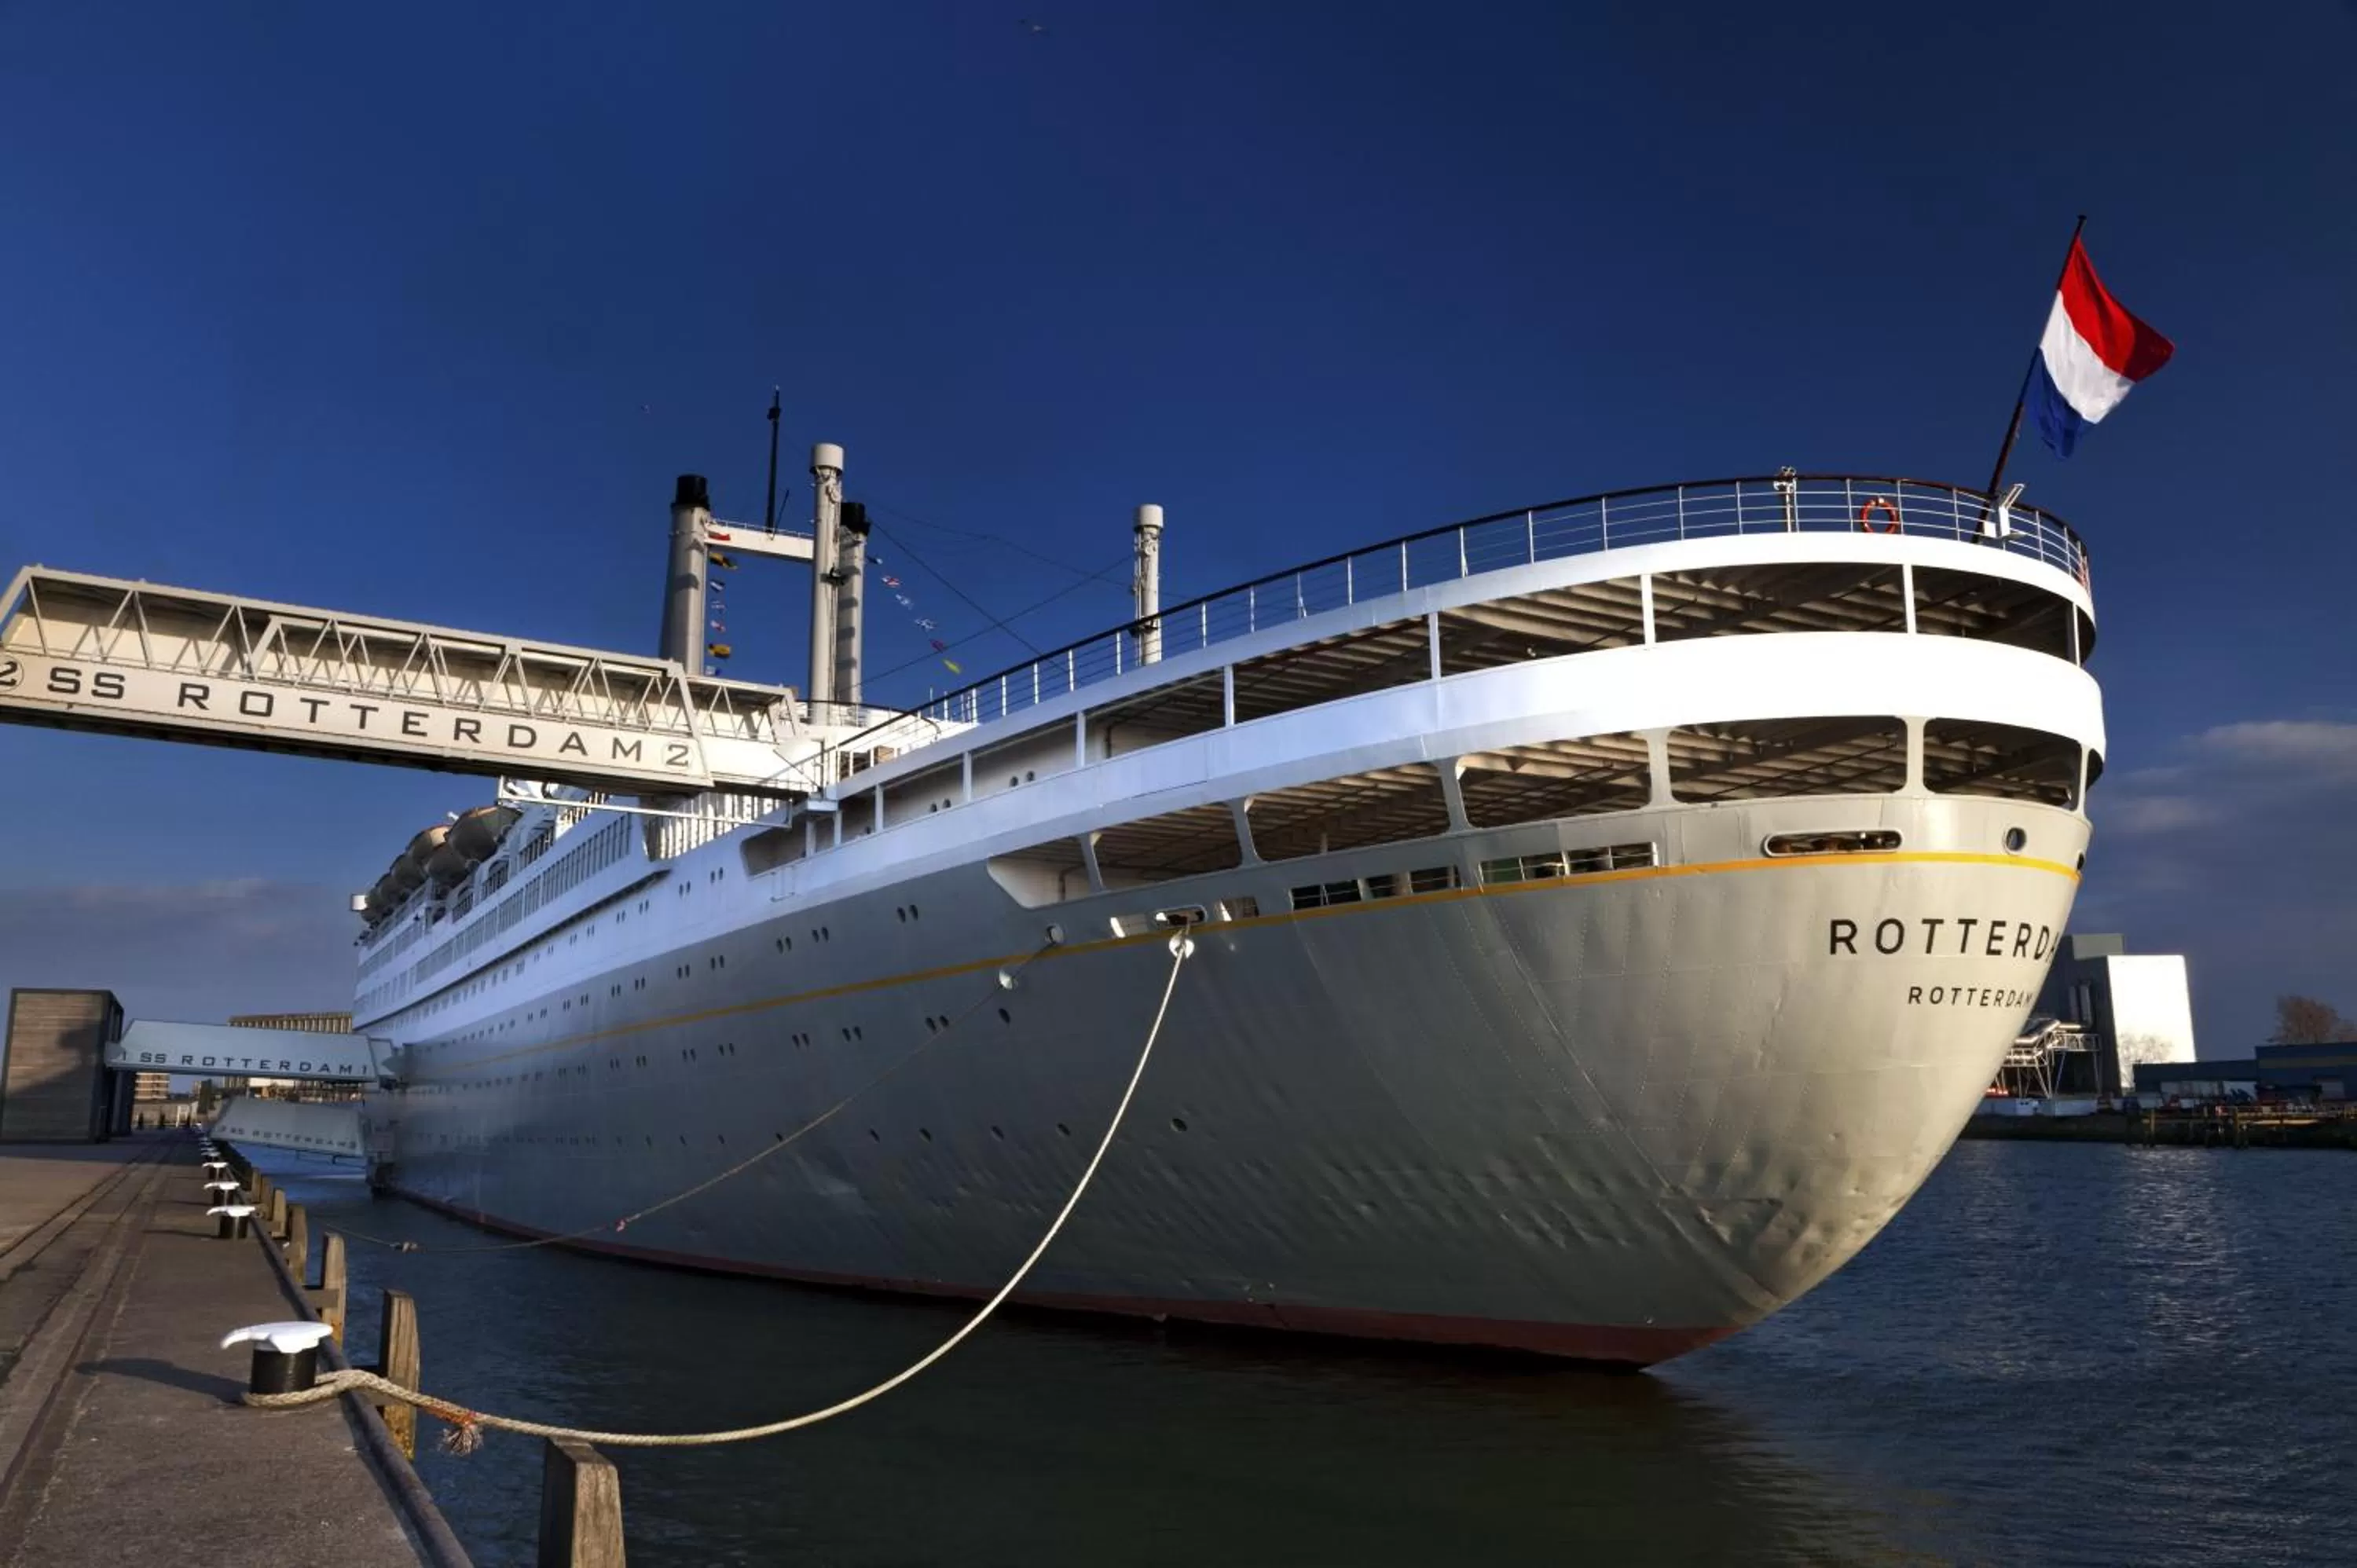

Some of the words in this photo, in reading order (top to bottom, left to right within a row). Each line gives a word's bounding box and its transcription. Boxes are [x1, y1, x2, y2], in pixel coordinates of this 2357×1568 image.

[0, 661, 18, 687] 2
[47, 666, 126, 700] SS
[178, 682, 642, 763] ROTTERDAM
[665, 744, 690, 768] 2
[140, 1052, 167, 1064] SS
[181, 1054, 353, 1075] ROTTERDAM
